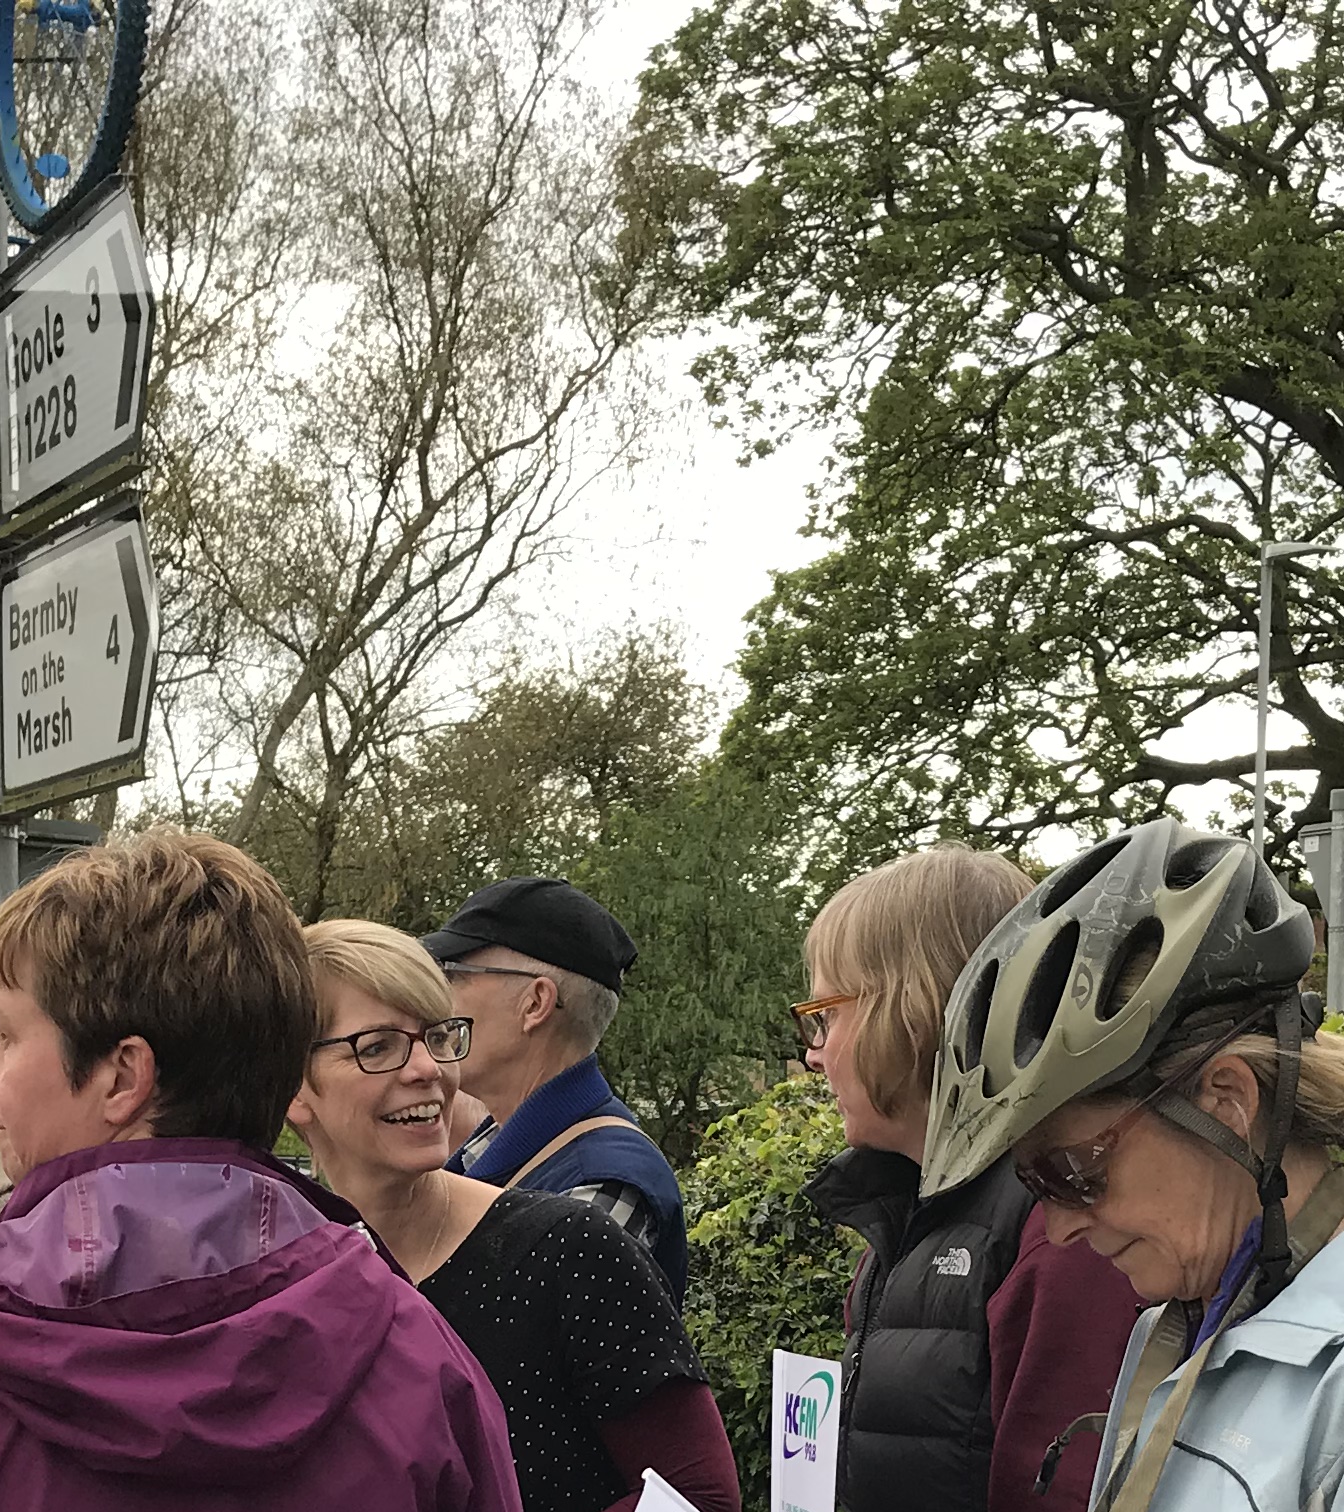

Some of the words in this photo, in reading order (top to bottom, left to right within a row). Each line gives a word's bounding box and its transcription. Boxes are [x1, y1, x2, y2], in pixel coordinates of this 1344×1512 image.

[85, 266, 101, 333] 3
[9, 582, 78, 651] Barmby
[106, 614, 120, 664] 4
[22, 667, 38, 697] on
[42, 651, 65, 689] the
[17, 696, 72, 759] Marsh
[785, 1392, 817, 1441] KCFM
